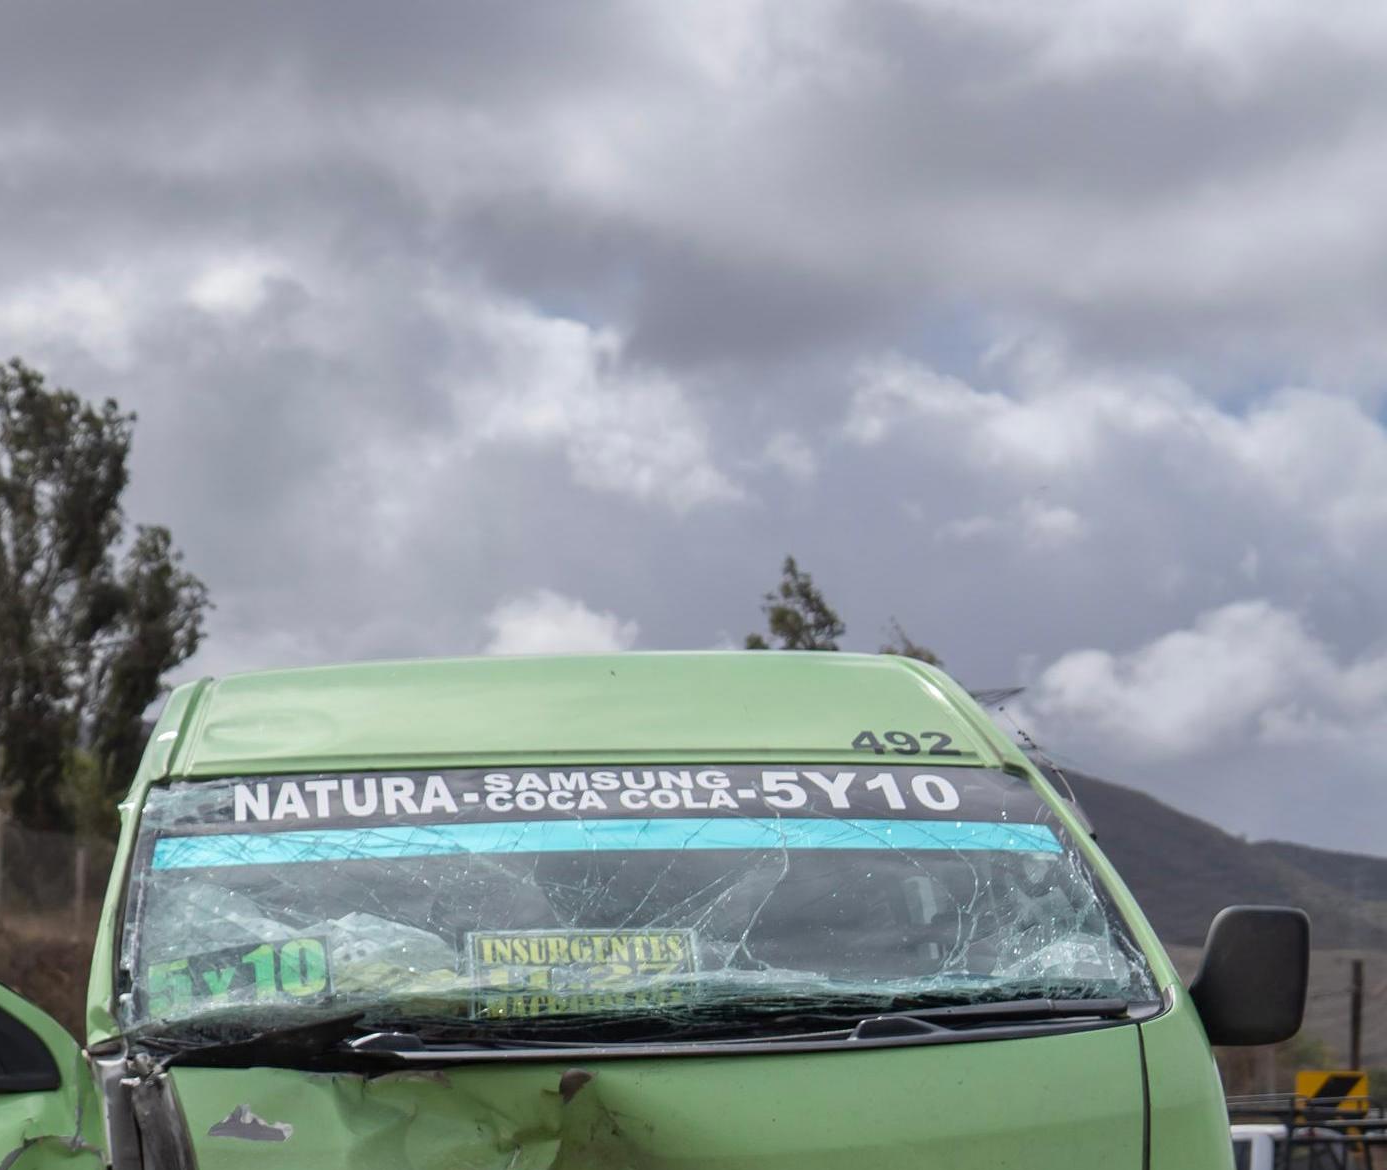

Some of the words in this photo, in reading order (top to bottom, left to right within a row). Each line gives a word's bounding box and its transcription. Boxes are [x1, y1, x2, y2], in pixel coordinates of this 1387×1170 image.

[850, 730, 962, 756] 492
[483, 770, 731, 792] SAMSUNG
[485, 789, 609, 813] COCA
[480, 936, 684, 966] INSURGENTES
[241, 938, 327, 998] 10
